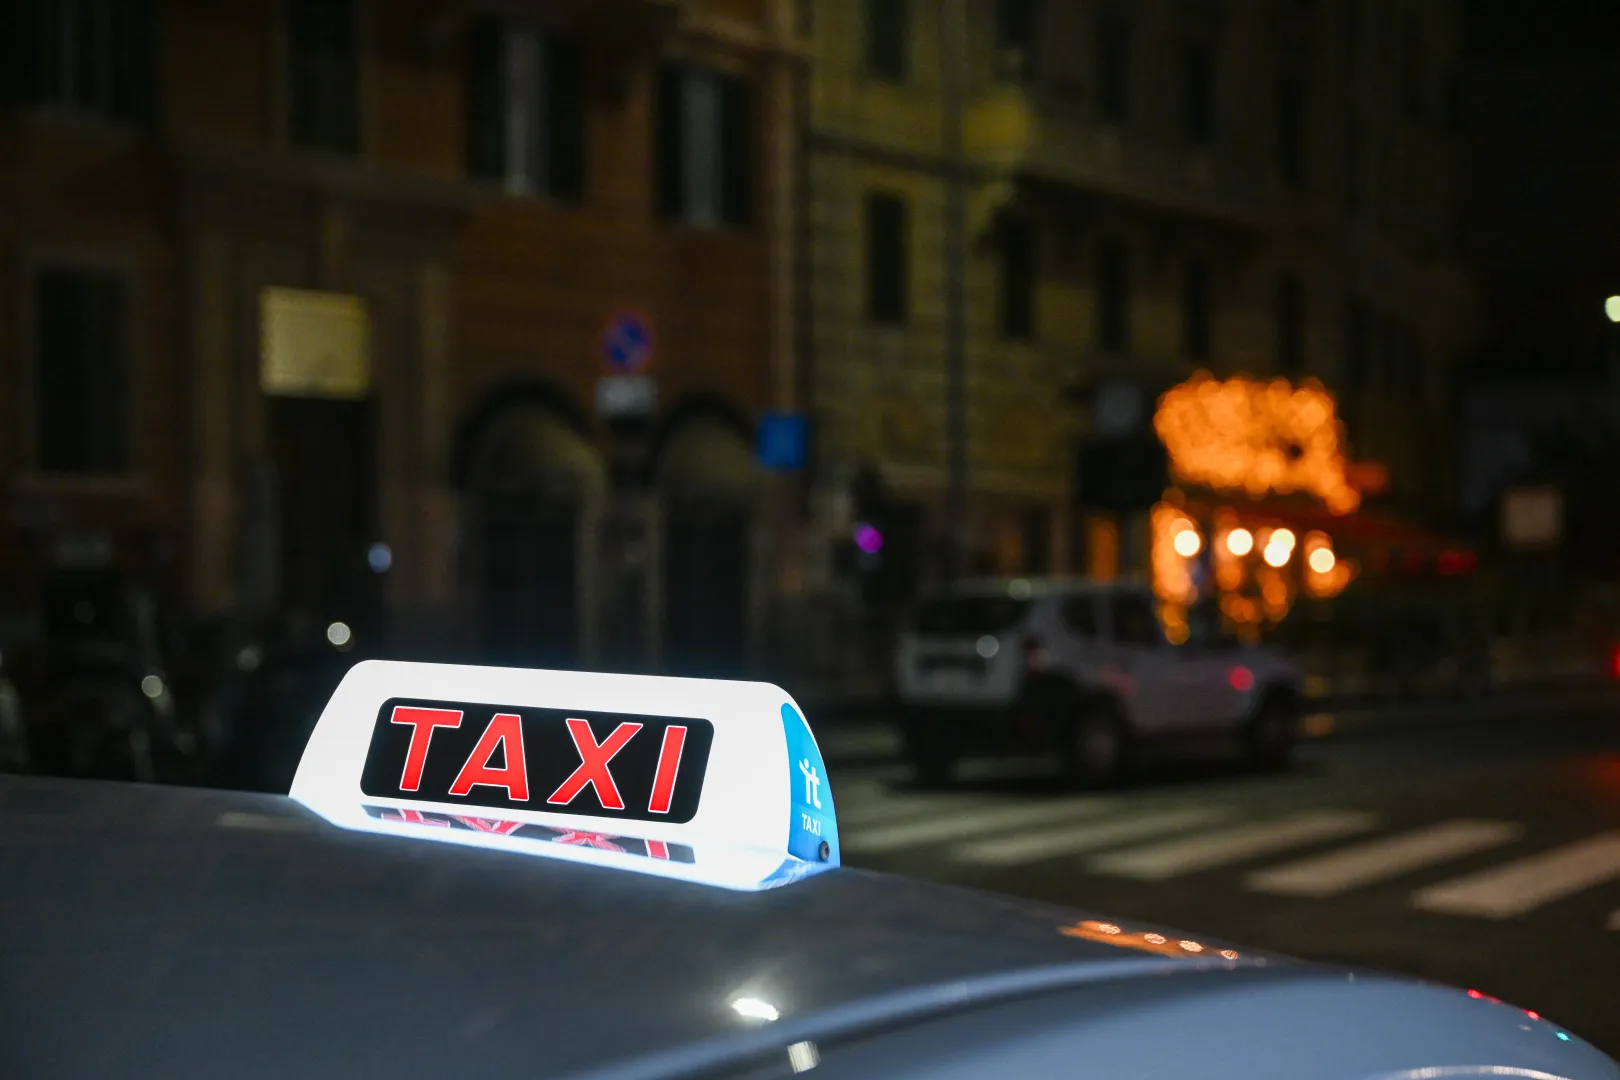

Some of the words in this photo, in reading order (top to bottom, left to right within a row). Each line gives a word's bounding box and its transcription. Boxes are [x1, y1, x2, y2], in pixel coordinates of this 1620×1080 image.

[390, 706, 688, 814] TAXI
[799, 758, 822, 809] it
[801, 813, 822, 837] TAXI
